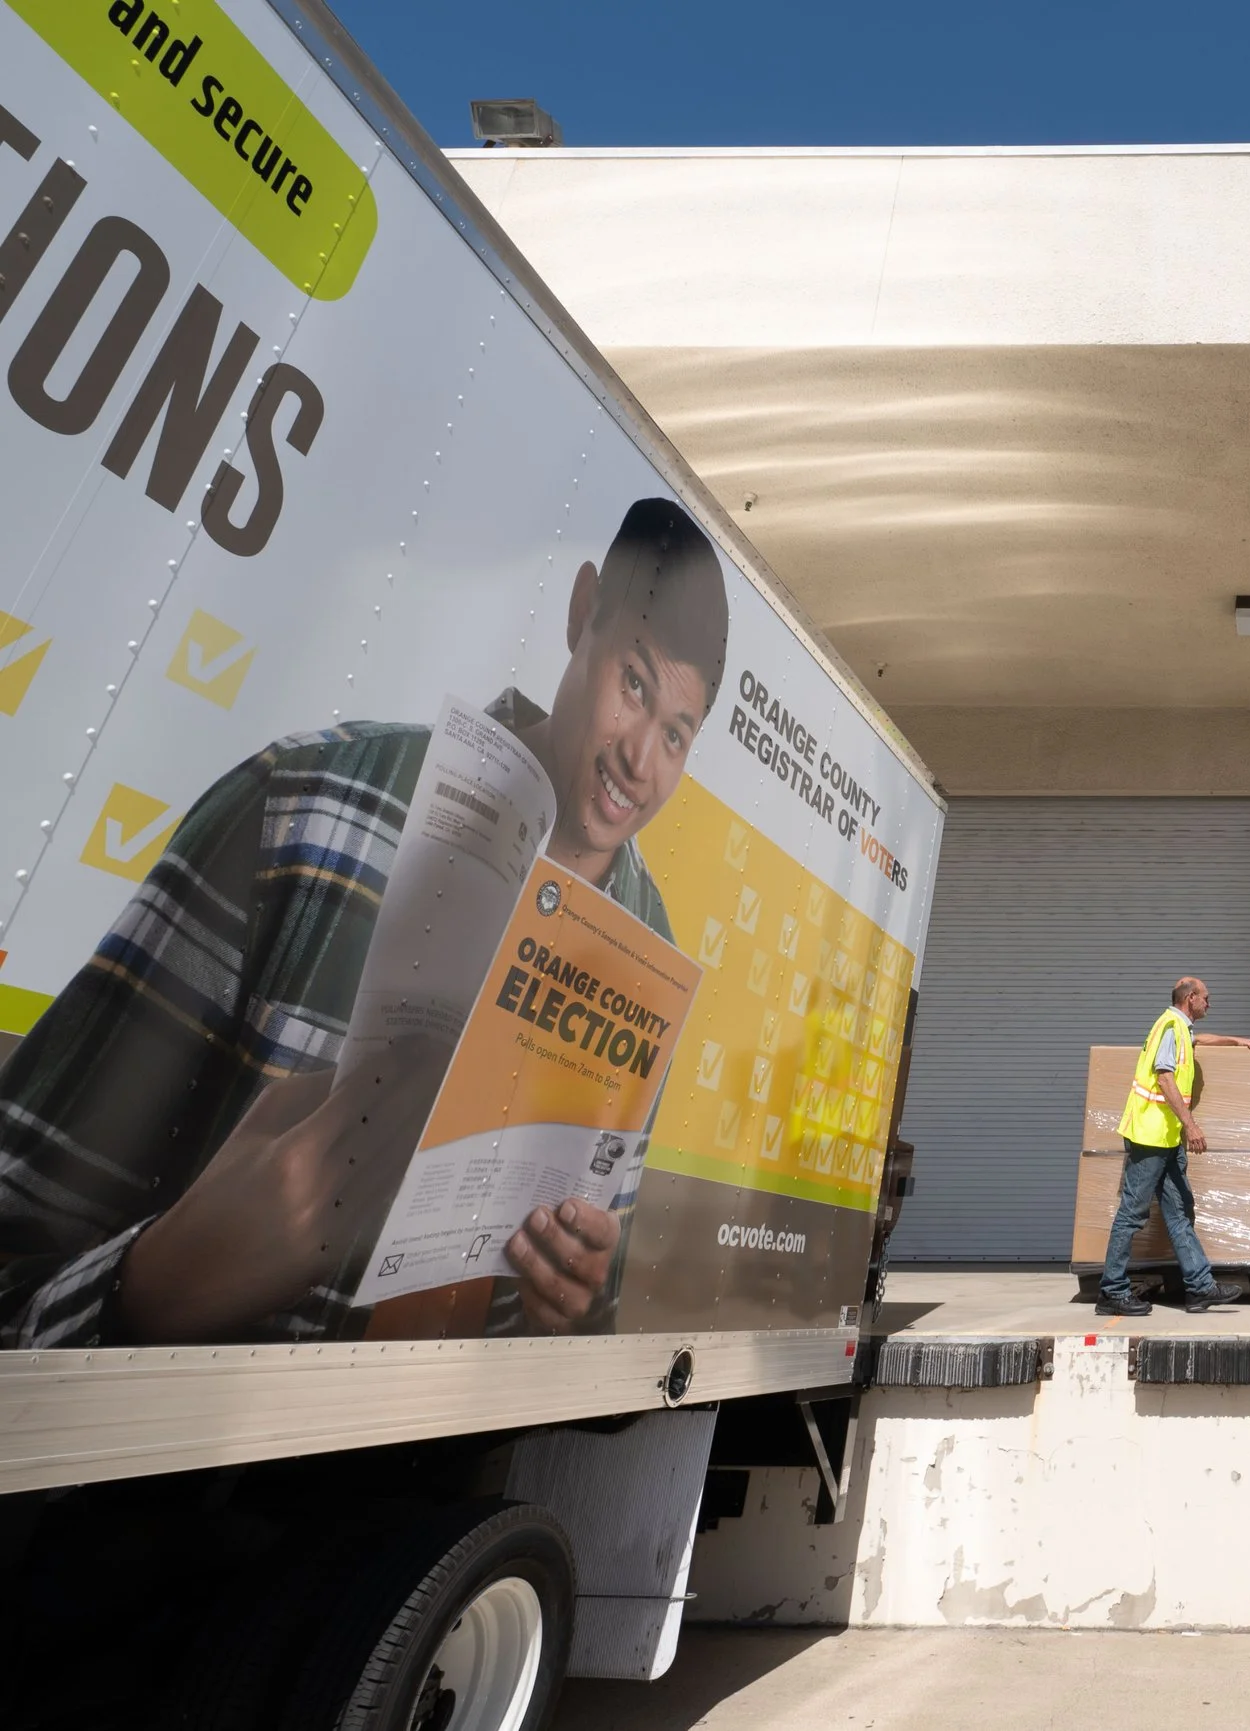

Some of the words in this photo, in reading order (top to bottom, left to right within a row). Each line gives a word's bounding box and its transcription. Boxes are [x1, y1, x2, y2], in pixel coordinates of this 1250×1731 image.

[108, 0, 203, 87] and
[190, 75, 313, 217] secure
[729, 704, 835, 825] REGISTRAR
[838, 809, 858, 842] OF
[860, 827, 908, 892] VOTERS
[739, 670, 817, 766] ORANGE
[820, 751, 881, 826] COUNTY
[495, 965, 660, 1080] ELECTION
[517, 936, 600, 1002] ORANGE
[600, 987, 671, 1039] COUNTY
[515, 1032, 536, 1051] Polls
[536, 1046, 557, 1063] open
[557, 1053, 577, 1072] from
[577, 1063, 595, 1080] 7am
[594, 1071, 603, 1084] to
[603, 1075, 621, 1092] 8pm
[717, 1223, 806, 1253] ocvote.com
